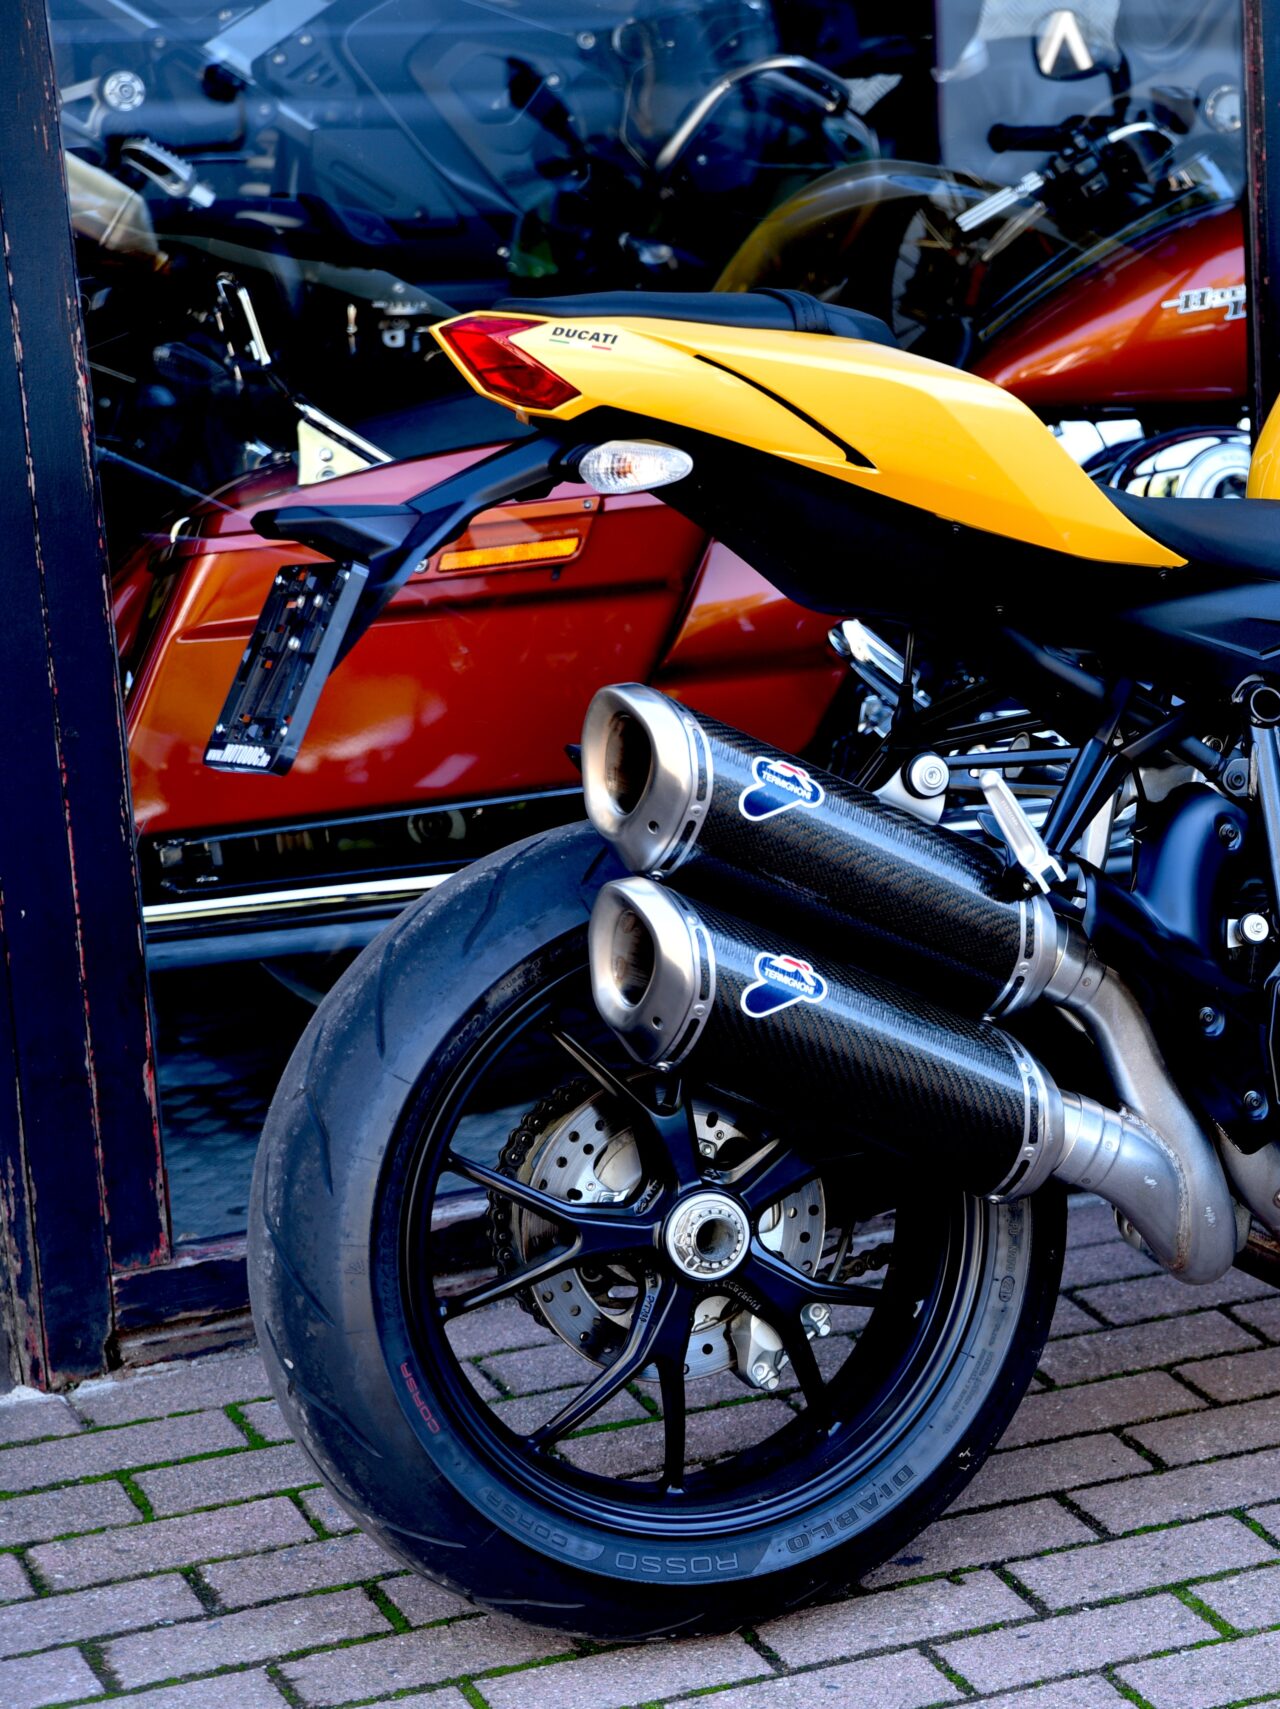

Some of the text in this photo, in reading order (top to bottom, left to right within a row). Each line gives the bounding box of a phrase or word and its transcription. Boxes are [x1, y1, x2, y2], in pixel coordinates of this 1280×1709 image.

[551, 326, 618, 345] DUCATI
[762, 770, 812, 801] TERMIGNONI
[764, 966, 815, 995] TERMIGNONI
[400, 1362, 441, 1434] CORSA
[486, 1464, 917, 1575] DIABLO ROSSO CORSA
